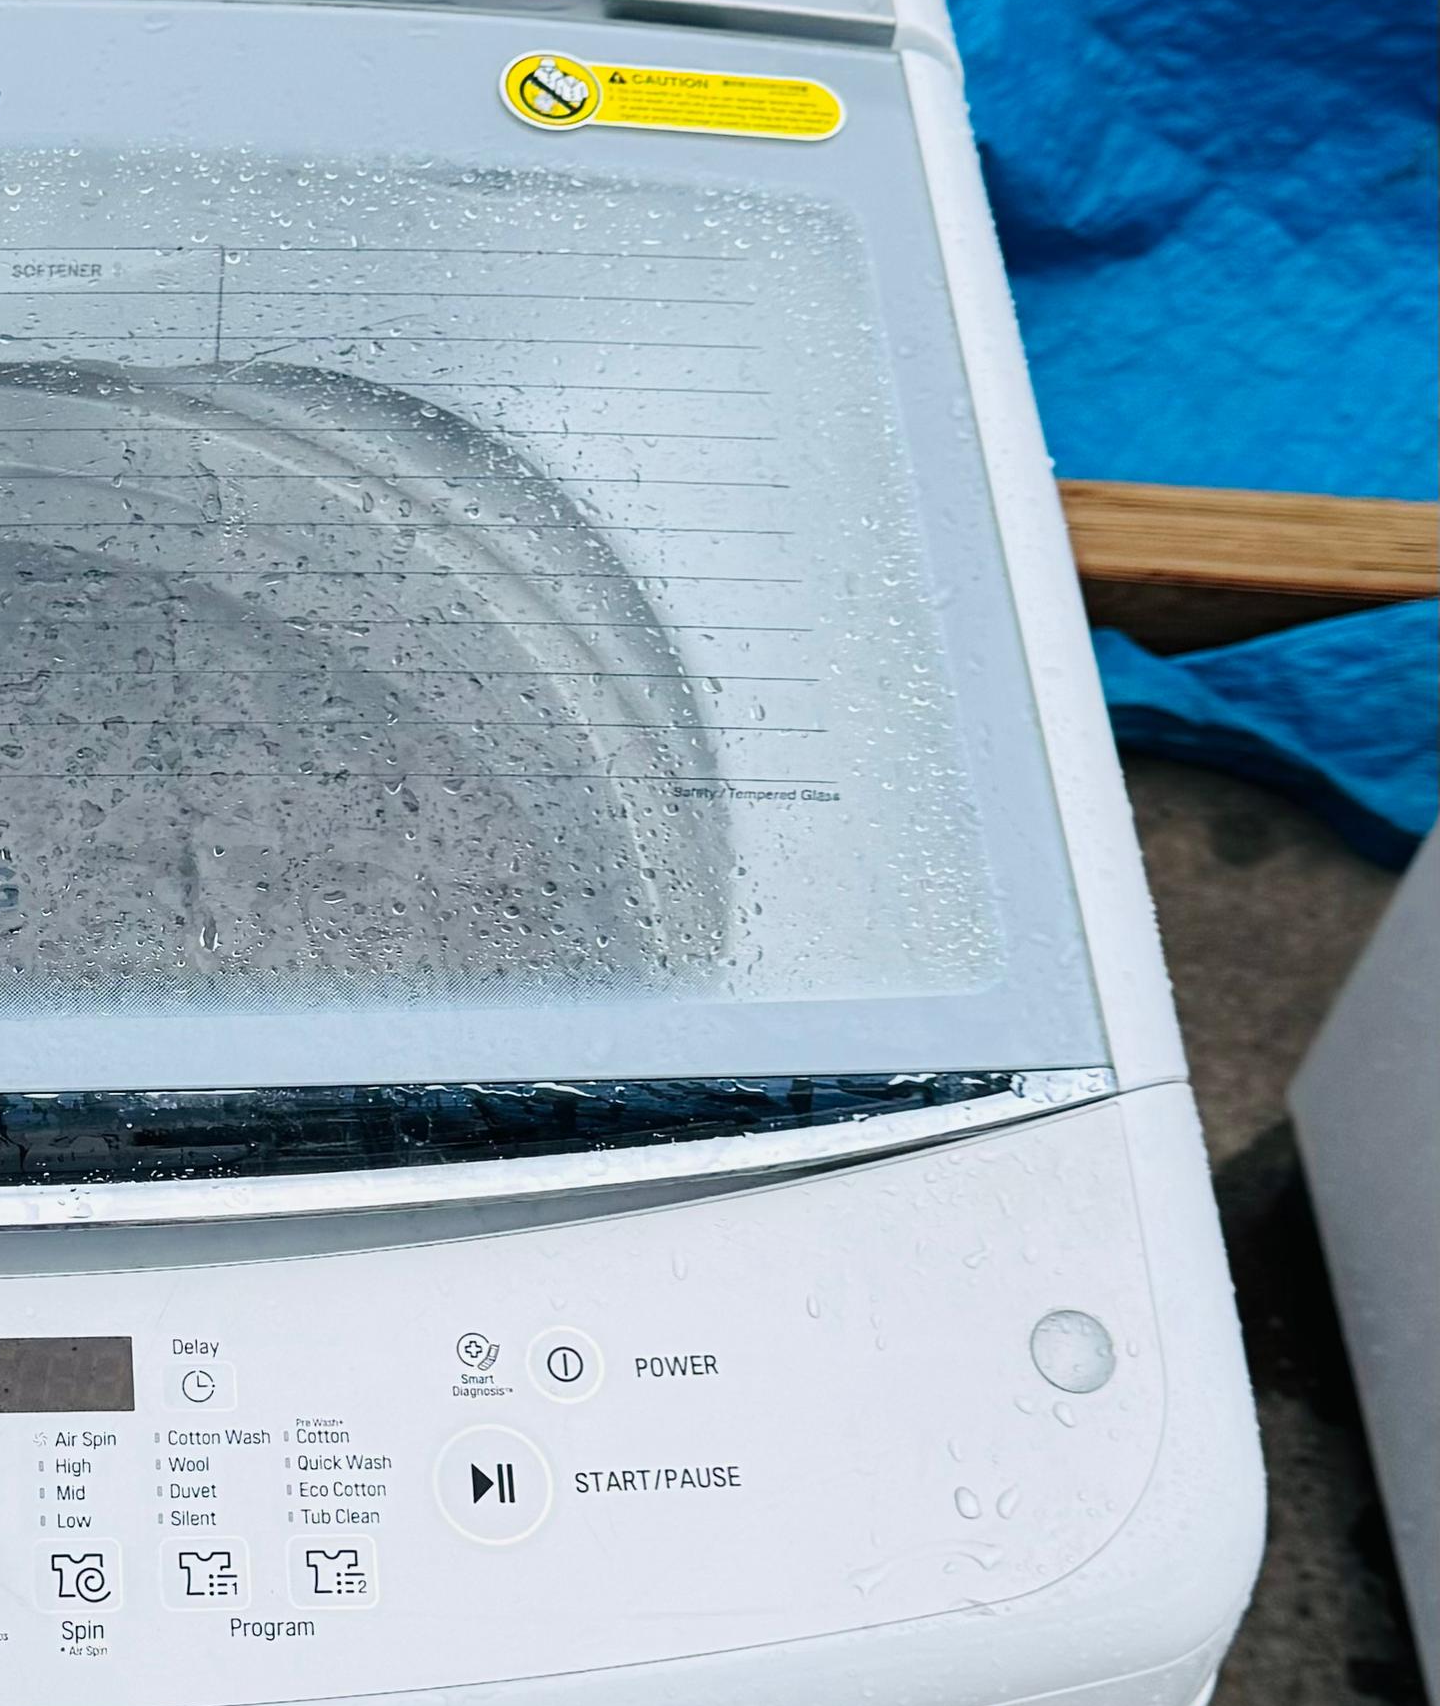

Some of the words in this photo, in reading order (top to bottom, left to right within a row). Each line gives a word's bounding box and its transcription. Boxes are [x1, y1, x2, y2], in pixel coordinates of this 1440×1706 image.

[632, 74, 709, 89] CAUTION
[11, 263, 101, 278] SOFTENER
[729, 788, 796, 802] Tempered
[801, 789, 840, 802] Glass
[172, 1338, 220, 1358] Delay
[635, 1354, 719, 1378] POWER
[461, 1374, 494, 1384] Smart
[55, 1431, 77, 1447] Air
[82, 1431, 117, 1450] Spin
[167, 1430, 221, 1446] Cotton
[224, 1429, 271, 1445] Wash
[296, 1428, 350, 1444] Cotton
[55, 1458, 91, 1478] High
[168, 1456, 209, 1473] Wool
[297, 1455, 343, 1471] Quick
[345, 1454, 392, 1470] Wash
[574, 1466, 742, 1494] START/PAUSE
[56, 1485, 86, 1501] Mid
[170, 1483, 217, 1499] Duvet
[298, 1481, 328, 1498] Eco
[333, 1481, 387, 1497] Cotton
[57, 1513, 92, 1529] Low
[170, 1510, 217, 1527] Silent
[300, 1508, 332, 1525] Tub
[335, 1508, 380, 1524] Clean
[231, 1581, 238, 1596] 1
[357, 1579, 367, 1594] 2
[61, 1620, 104, 1644] Spin
[230, 1617, 315, 1642] Program
[69, 1646, 83, 1656] Air
[86, 1645, 107, 1656] Spin
